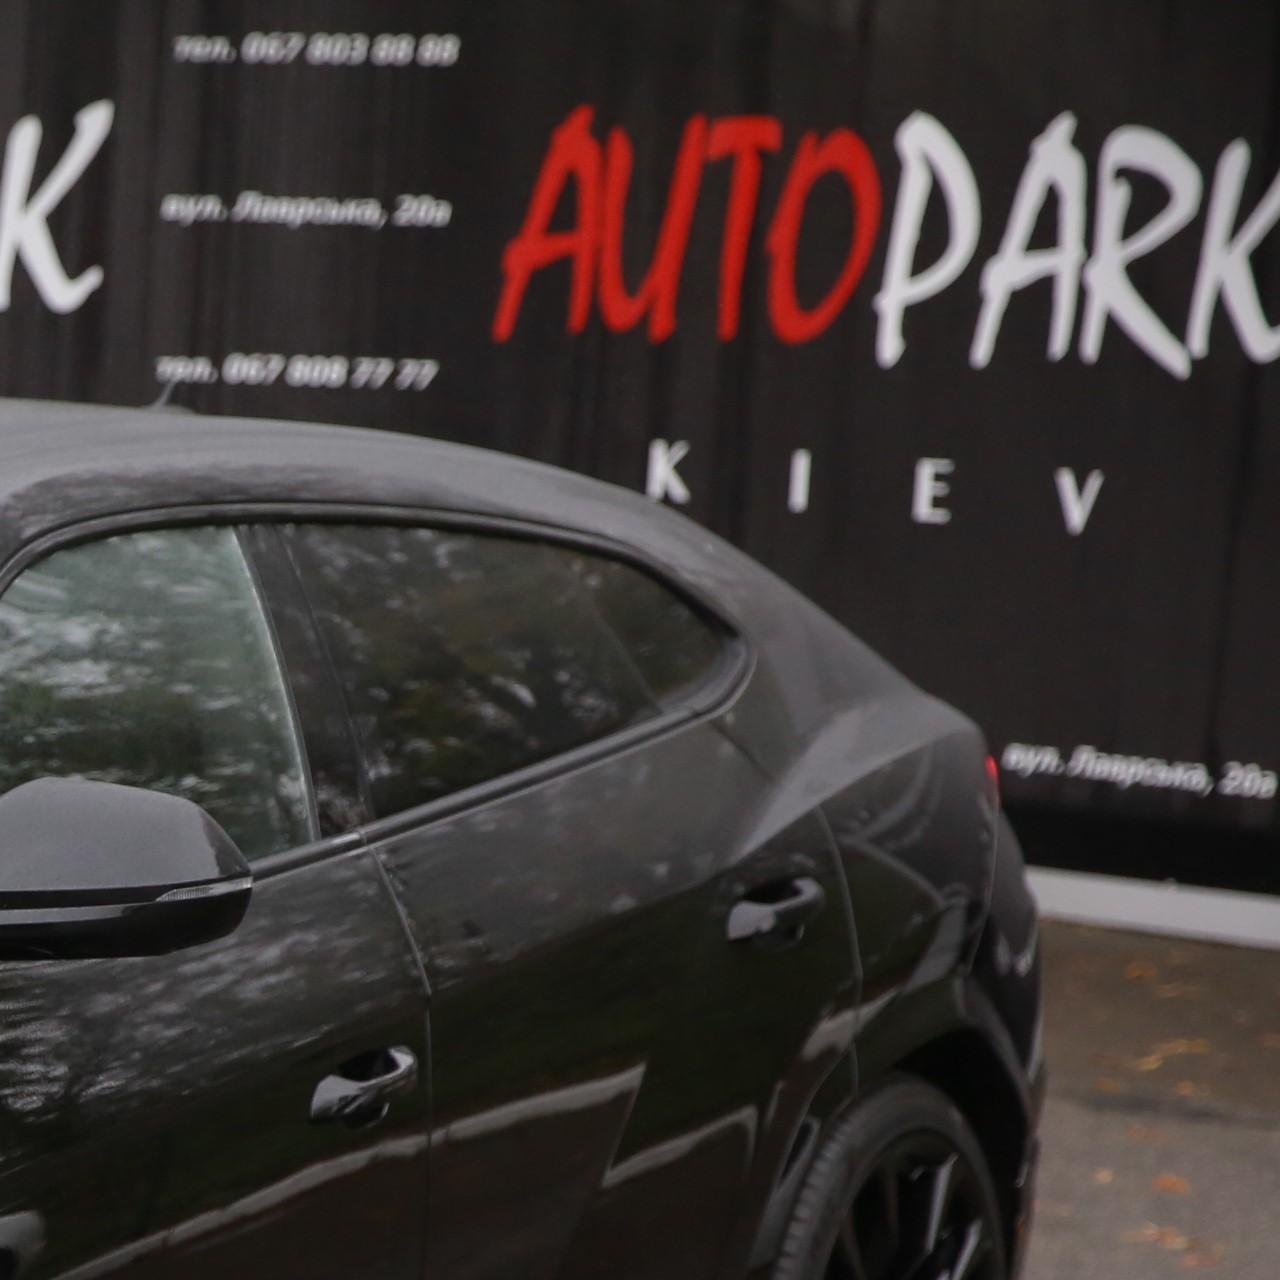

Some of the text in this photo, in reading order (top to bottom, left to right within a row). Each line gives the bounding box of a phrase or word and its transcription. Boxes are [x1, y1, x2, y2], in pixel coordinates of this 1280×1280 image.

[240, 31, 306, 64] 067
[370, 33, 416, 66] 88
[416, 33, 461, 67] 88
[221, 352, 286, 386] 067
[350, 356, 395, 390] 77
[394, 358, 440, 391] 77
